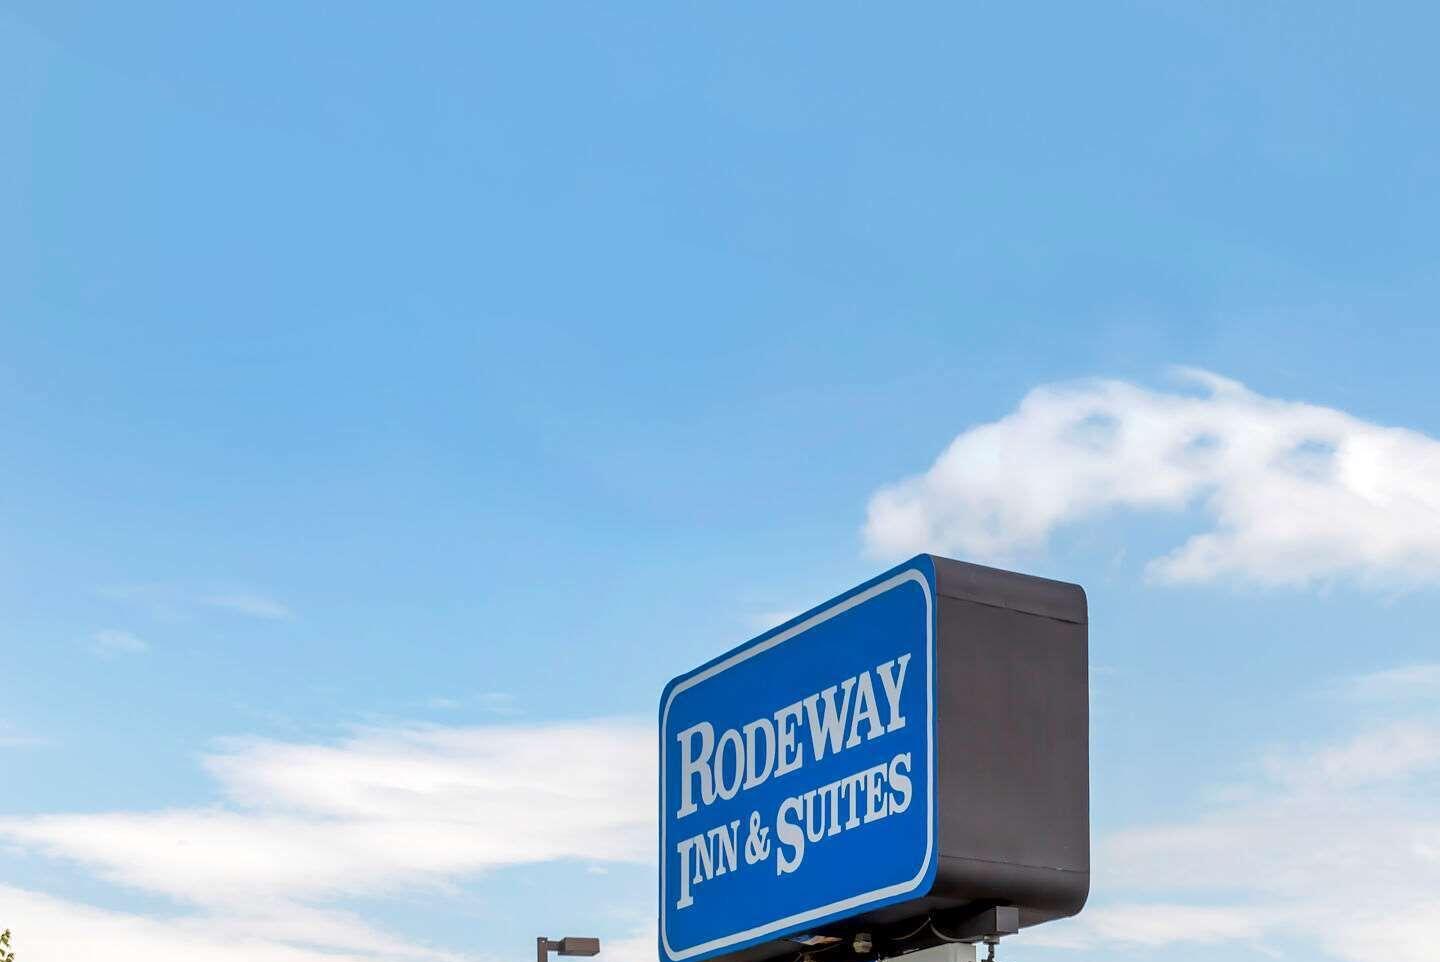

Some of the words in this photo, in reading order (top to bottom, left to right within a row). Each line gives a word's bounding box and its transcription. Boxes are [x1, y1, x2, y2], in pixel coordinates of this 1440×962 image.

[677, 653, 912, 819] RODEWAY
[677, 820, 740, 909] INN
[745, 811, 771, 865] &
[777, 752, 913, 876] SUITES
